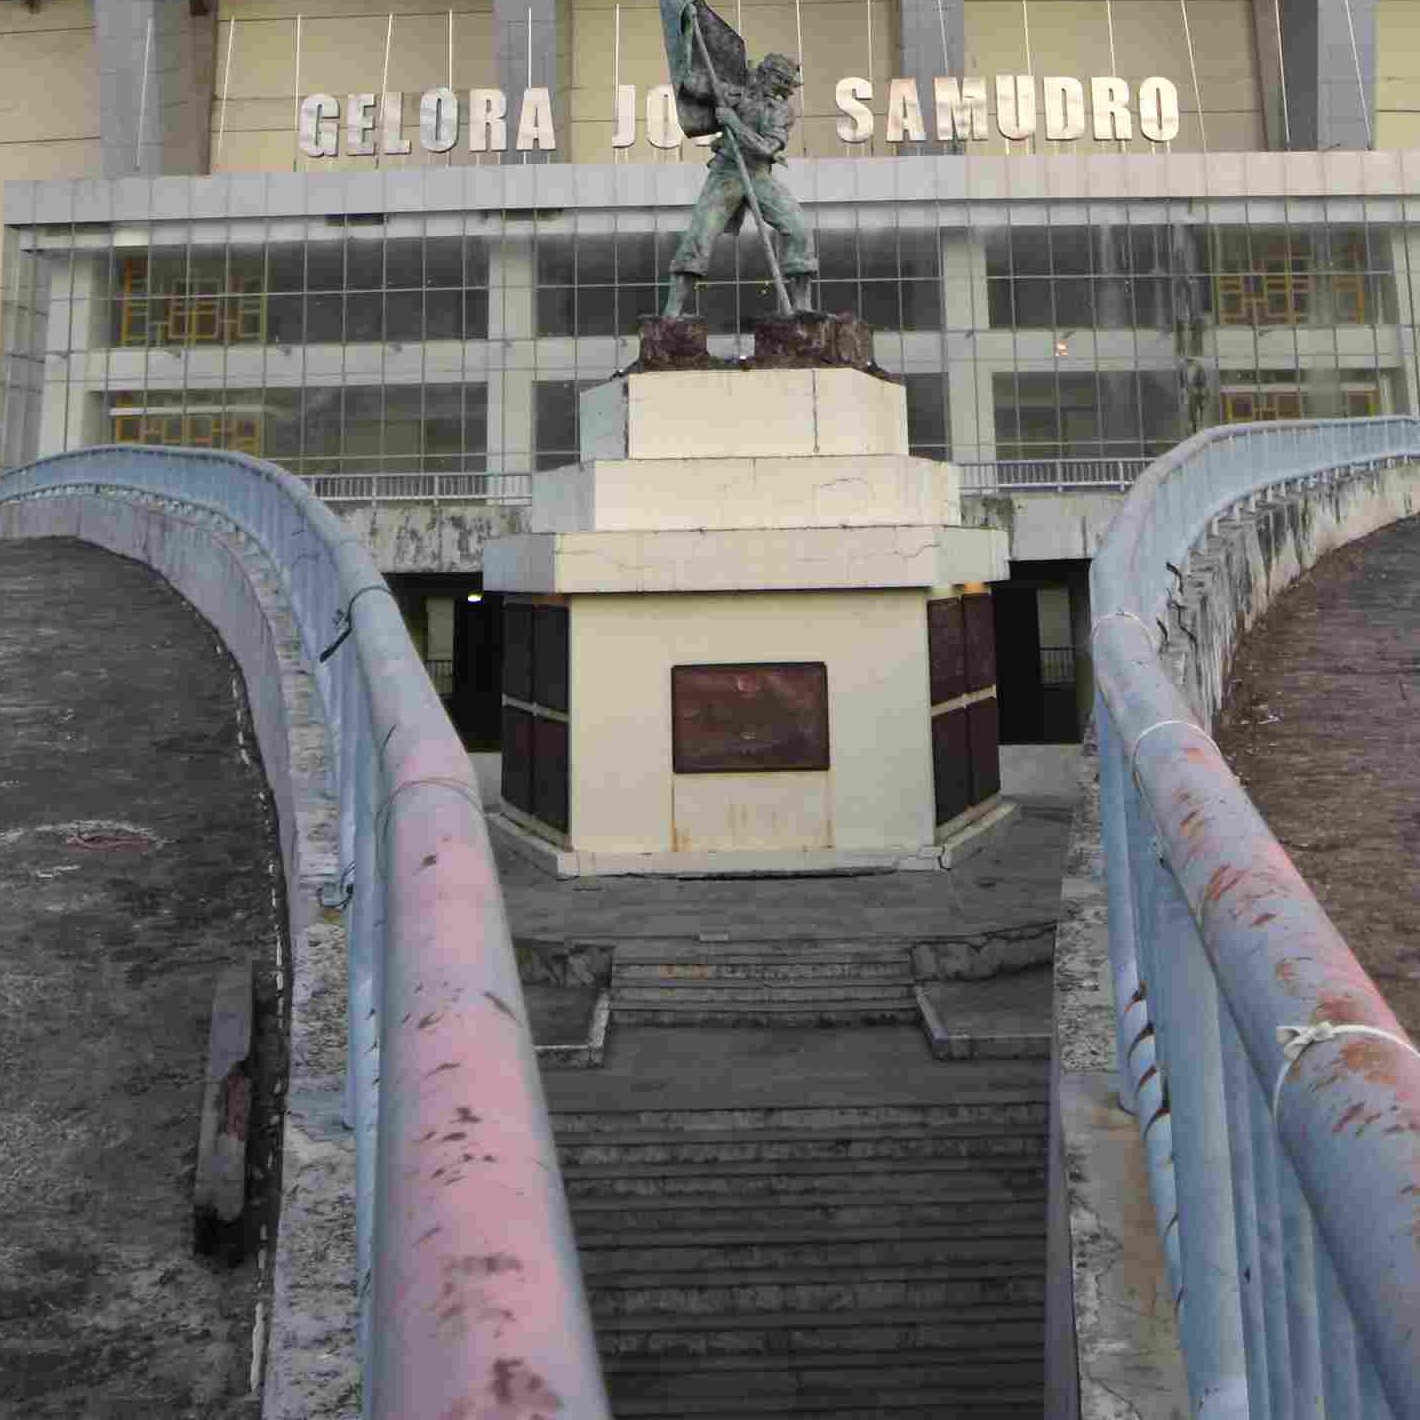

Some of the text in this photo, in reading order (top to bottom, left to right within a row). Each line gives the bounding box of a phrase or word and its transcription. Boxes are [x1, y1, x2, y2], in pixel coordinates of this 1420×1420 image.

[299, 75, 1179, 157] GELORA JO SAMUDRO
